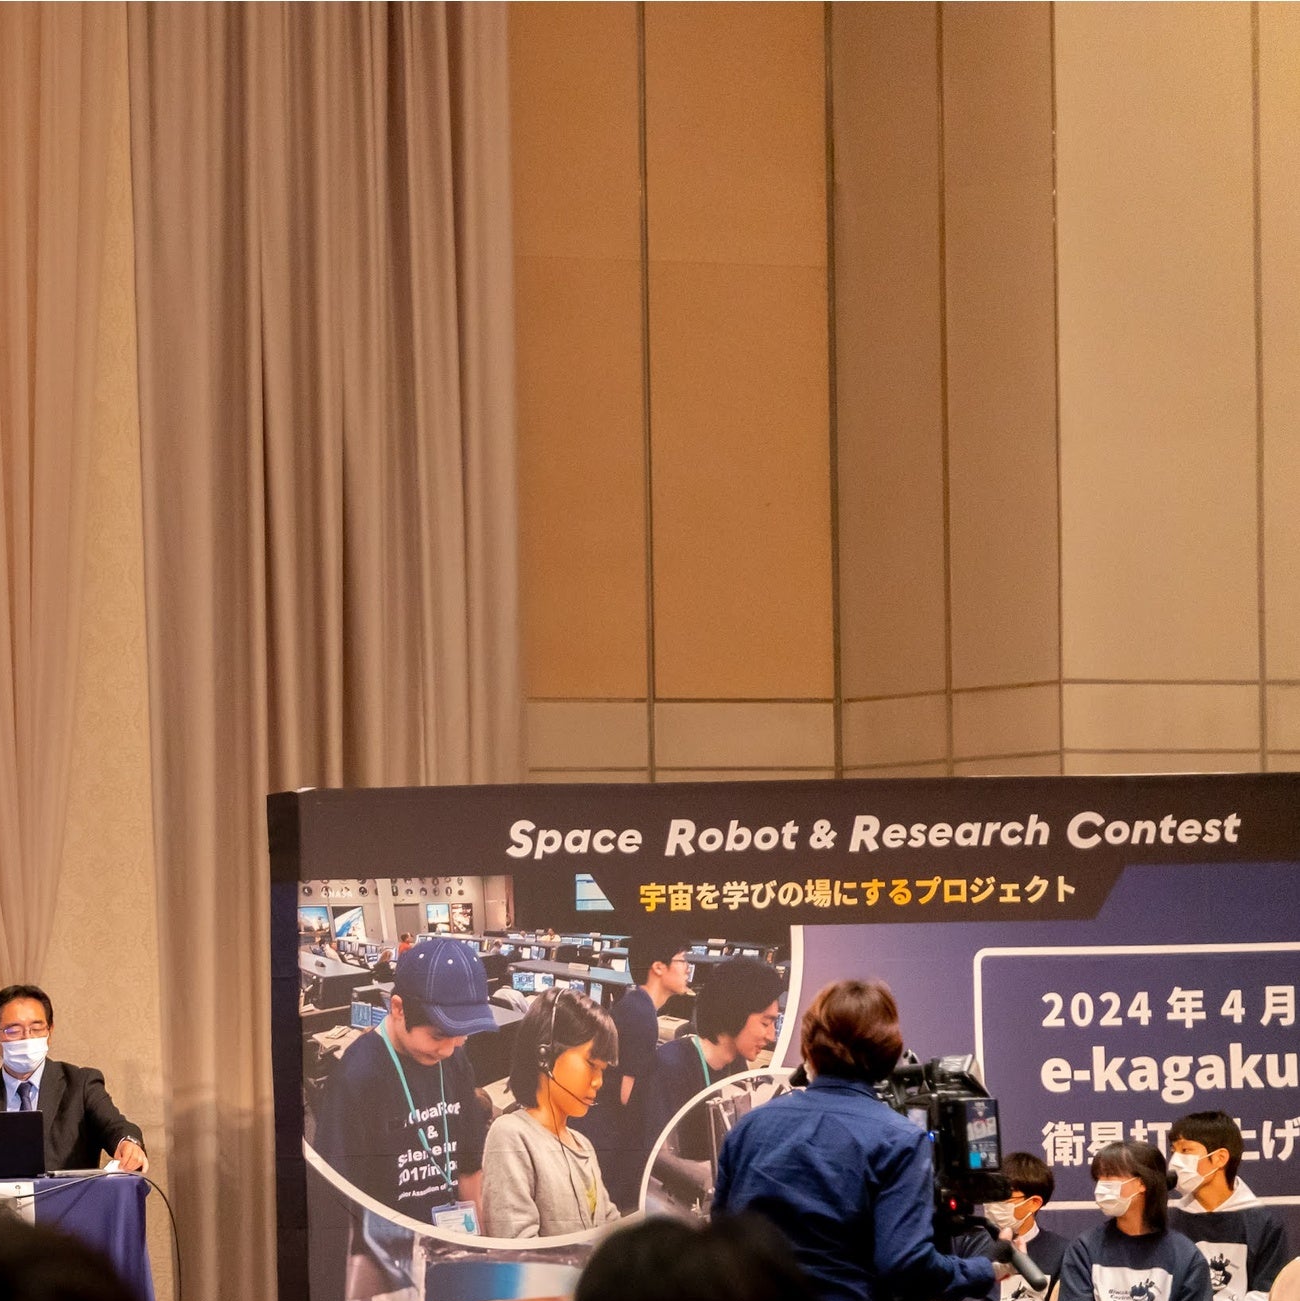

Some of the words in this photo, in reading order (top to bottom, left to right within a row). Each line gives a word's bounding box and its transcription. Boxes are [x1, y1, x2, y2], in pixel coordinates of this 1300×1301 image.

[505, 819, 643, 860] Space
[664, 818, 800, 857] Robot
[808, 818, 838, 850] &
[848, 813, 1051, 853] Research
[1066, 811, 1242, 850] Contest
[638, 874, 1076, 912] 宇宙を学びの場にするプロジェクト
[1040, 1042, 1299, 1104] e-kagaku
